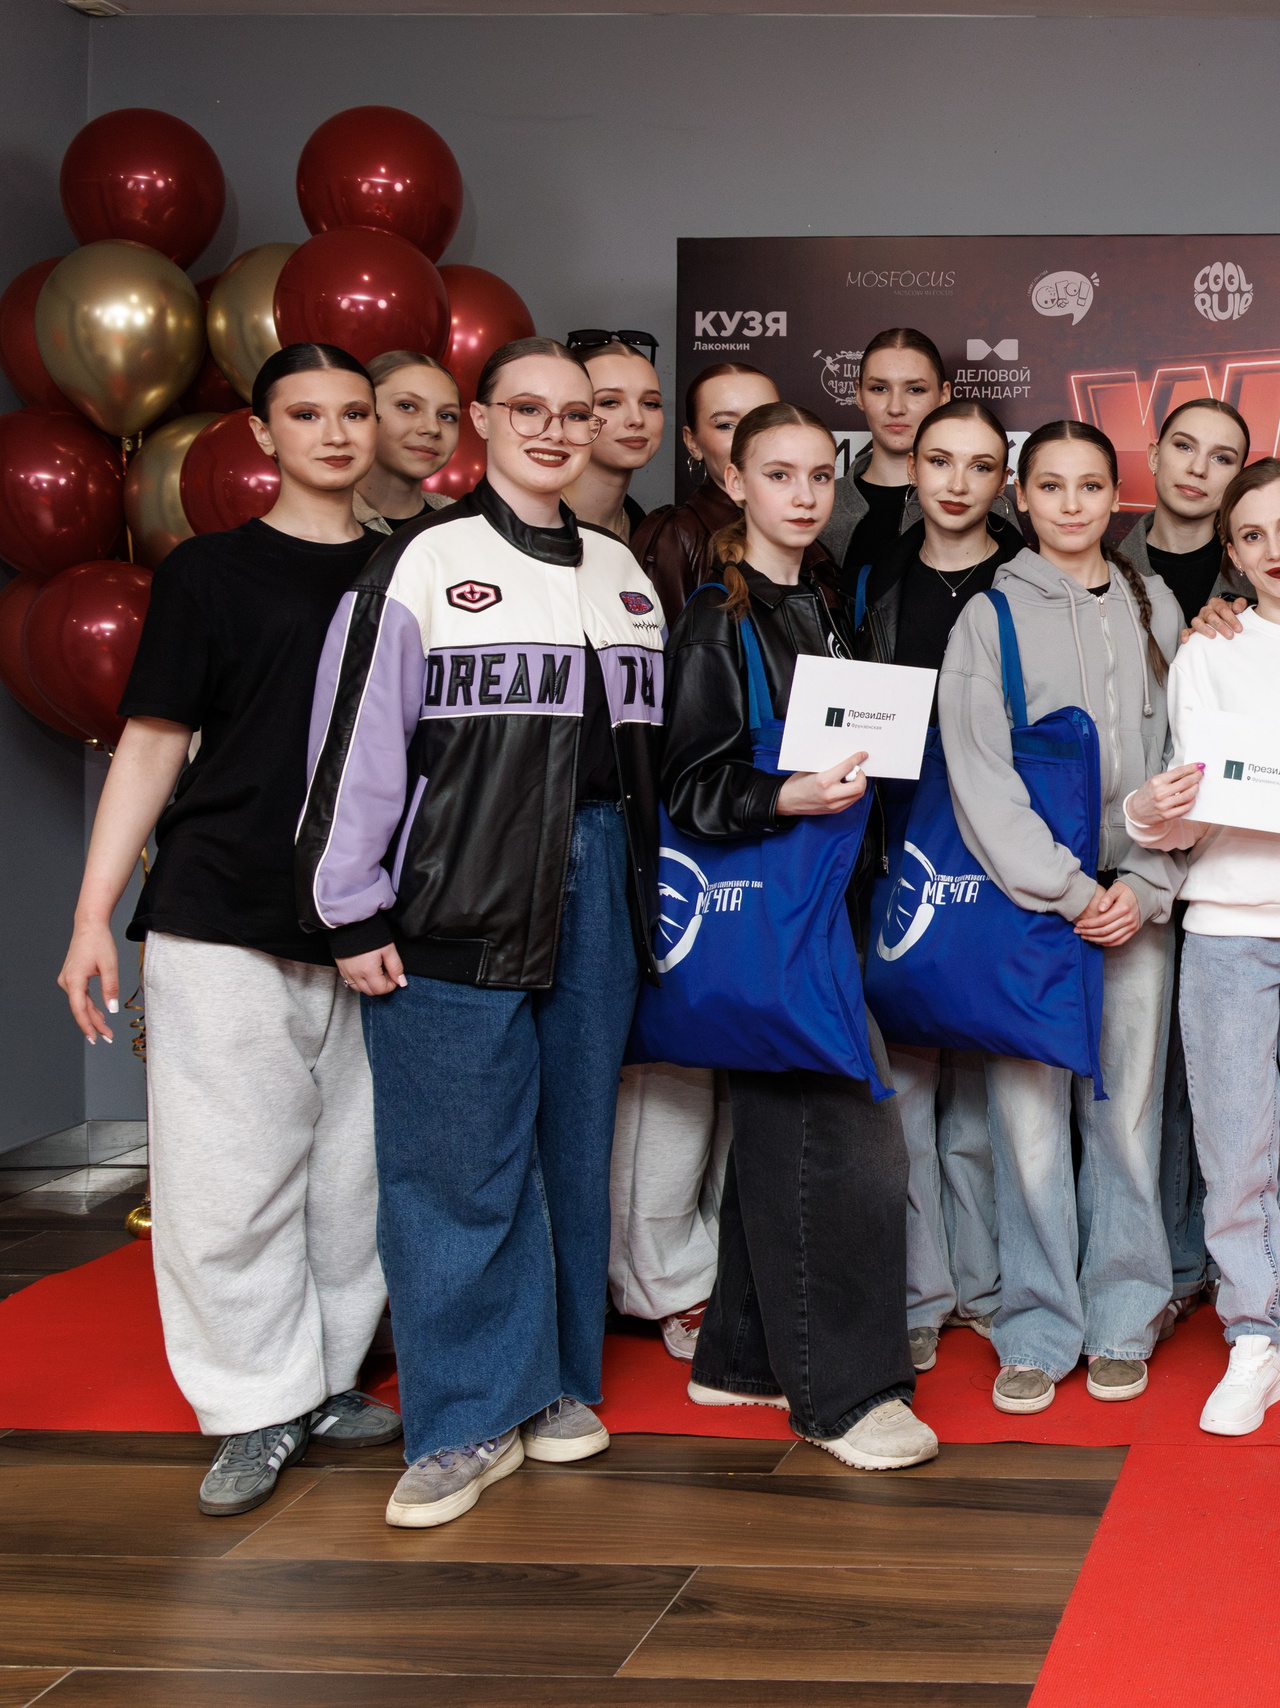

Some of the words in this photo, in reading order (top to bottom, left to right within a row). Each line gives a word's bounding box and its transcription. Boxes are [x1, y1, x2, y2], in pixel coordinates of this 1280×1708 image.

[845, 270, 956, 288] MOSFOCUS
[1193, 261, 1253, 293] COOL
[694, 310, 788, 337] КУЗЯ
[693, 341, 750, 351] Лакомкин
[843, 364, 861, 379] ЦИ
[954, 366, 1031, 384] ДЕЛОВОЙ
[828, 380, 857, 395] ЧУД
[953, 385, 1031, 400] СТАНДАРТ
[424, 653, 571, 706] DREAM
[848, 710, 896, 721] ПрезиДЕНТ
[695, 888, 743, 914] МЕЧТА
[921, 881, 979, 905] МЕЧТА
